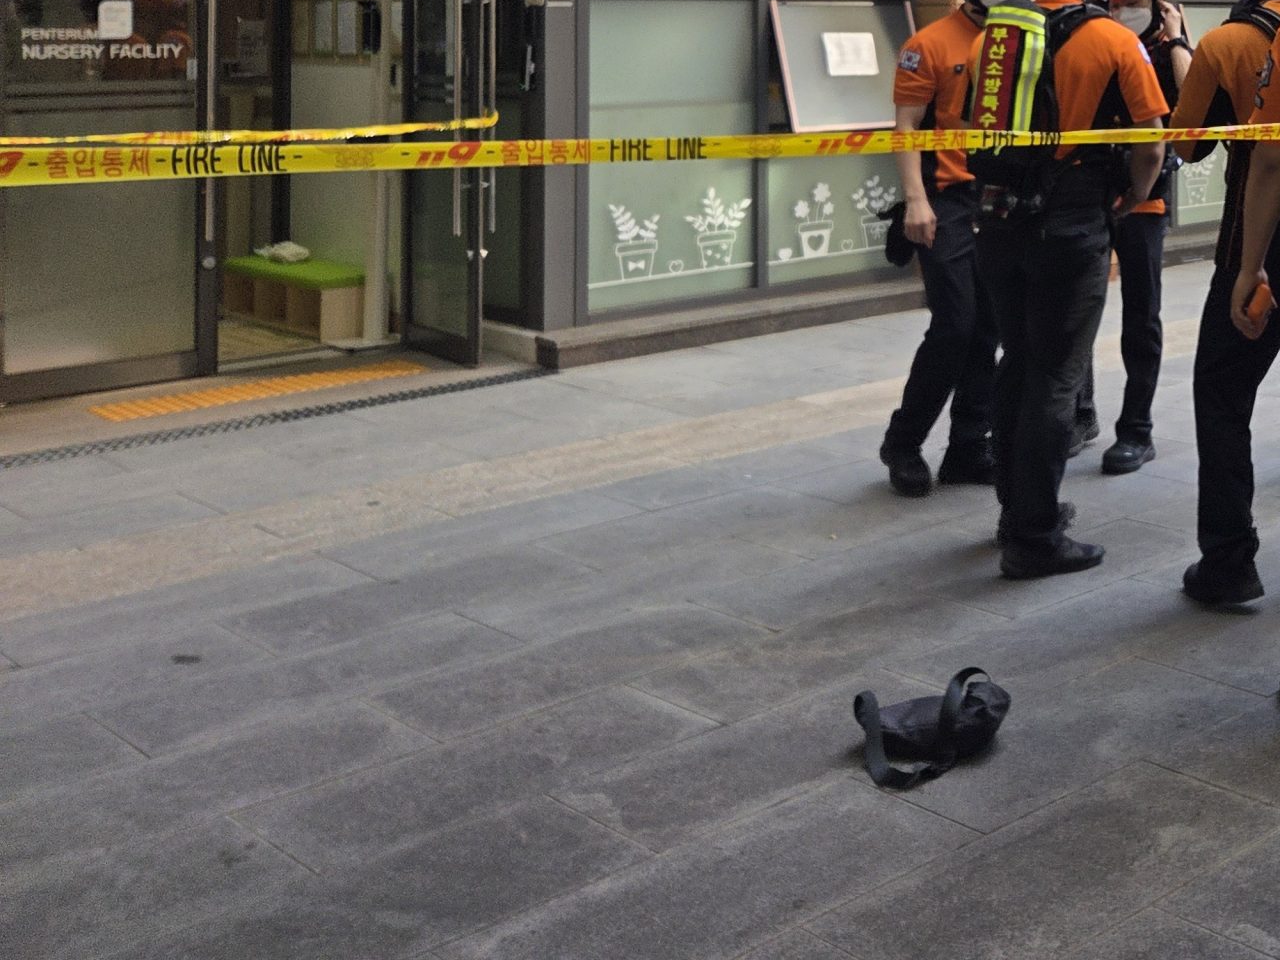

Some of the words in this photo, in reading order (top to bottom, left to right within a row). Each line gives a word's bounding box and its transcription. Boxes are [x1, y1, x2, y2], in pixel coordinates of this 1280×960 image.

[22, 43, 105, 60] NURSERY
[110, 43, 185, 60] FACILITY
[171, 145, 223, 174] FIRE
[237, 143, 287, 172] LINE
[609, 138, 653, 161] FIRE
[666, 136, 708, 160] LINE
